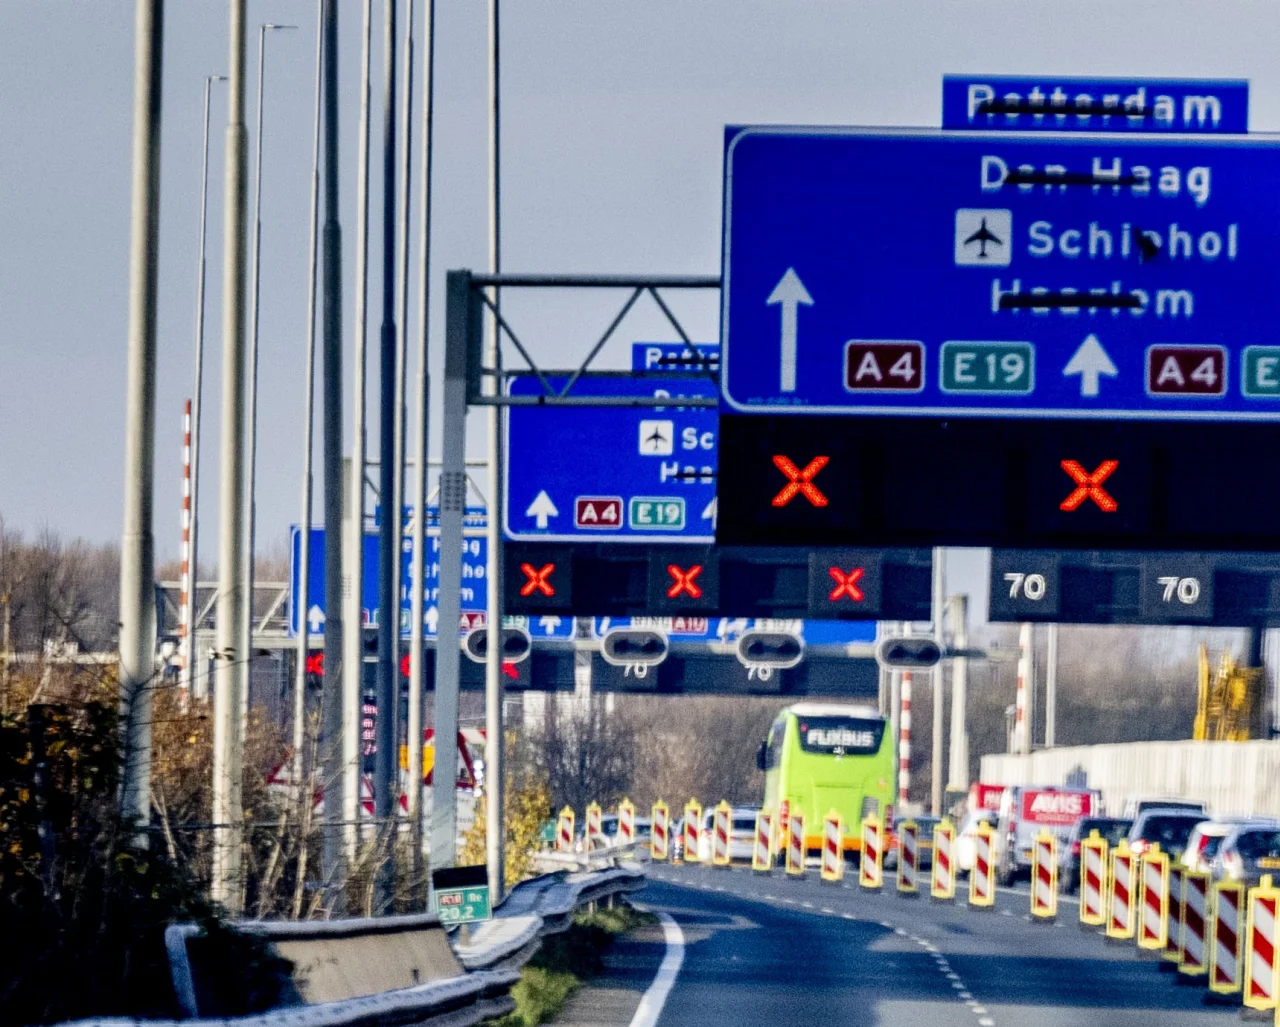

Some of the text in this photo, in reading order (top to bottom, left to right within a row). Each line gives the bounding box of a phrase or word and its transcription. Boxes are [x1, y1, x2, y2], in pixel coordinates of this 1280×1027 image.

[853, 350, 918, 383] A4
[952, 350, 1026, 384] E19
[1155, 353, 1219, 387] A4
[580, 502, 618, 526] A4
[637, 502, 681, 526] E19
[1004, 572, 1046, 600] 70
[1157, 576, 1200, 603] 70
[807, 729, 874, 747] FLIXBUS
